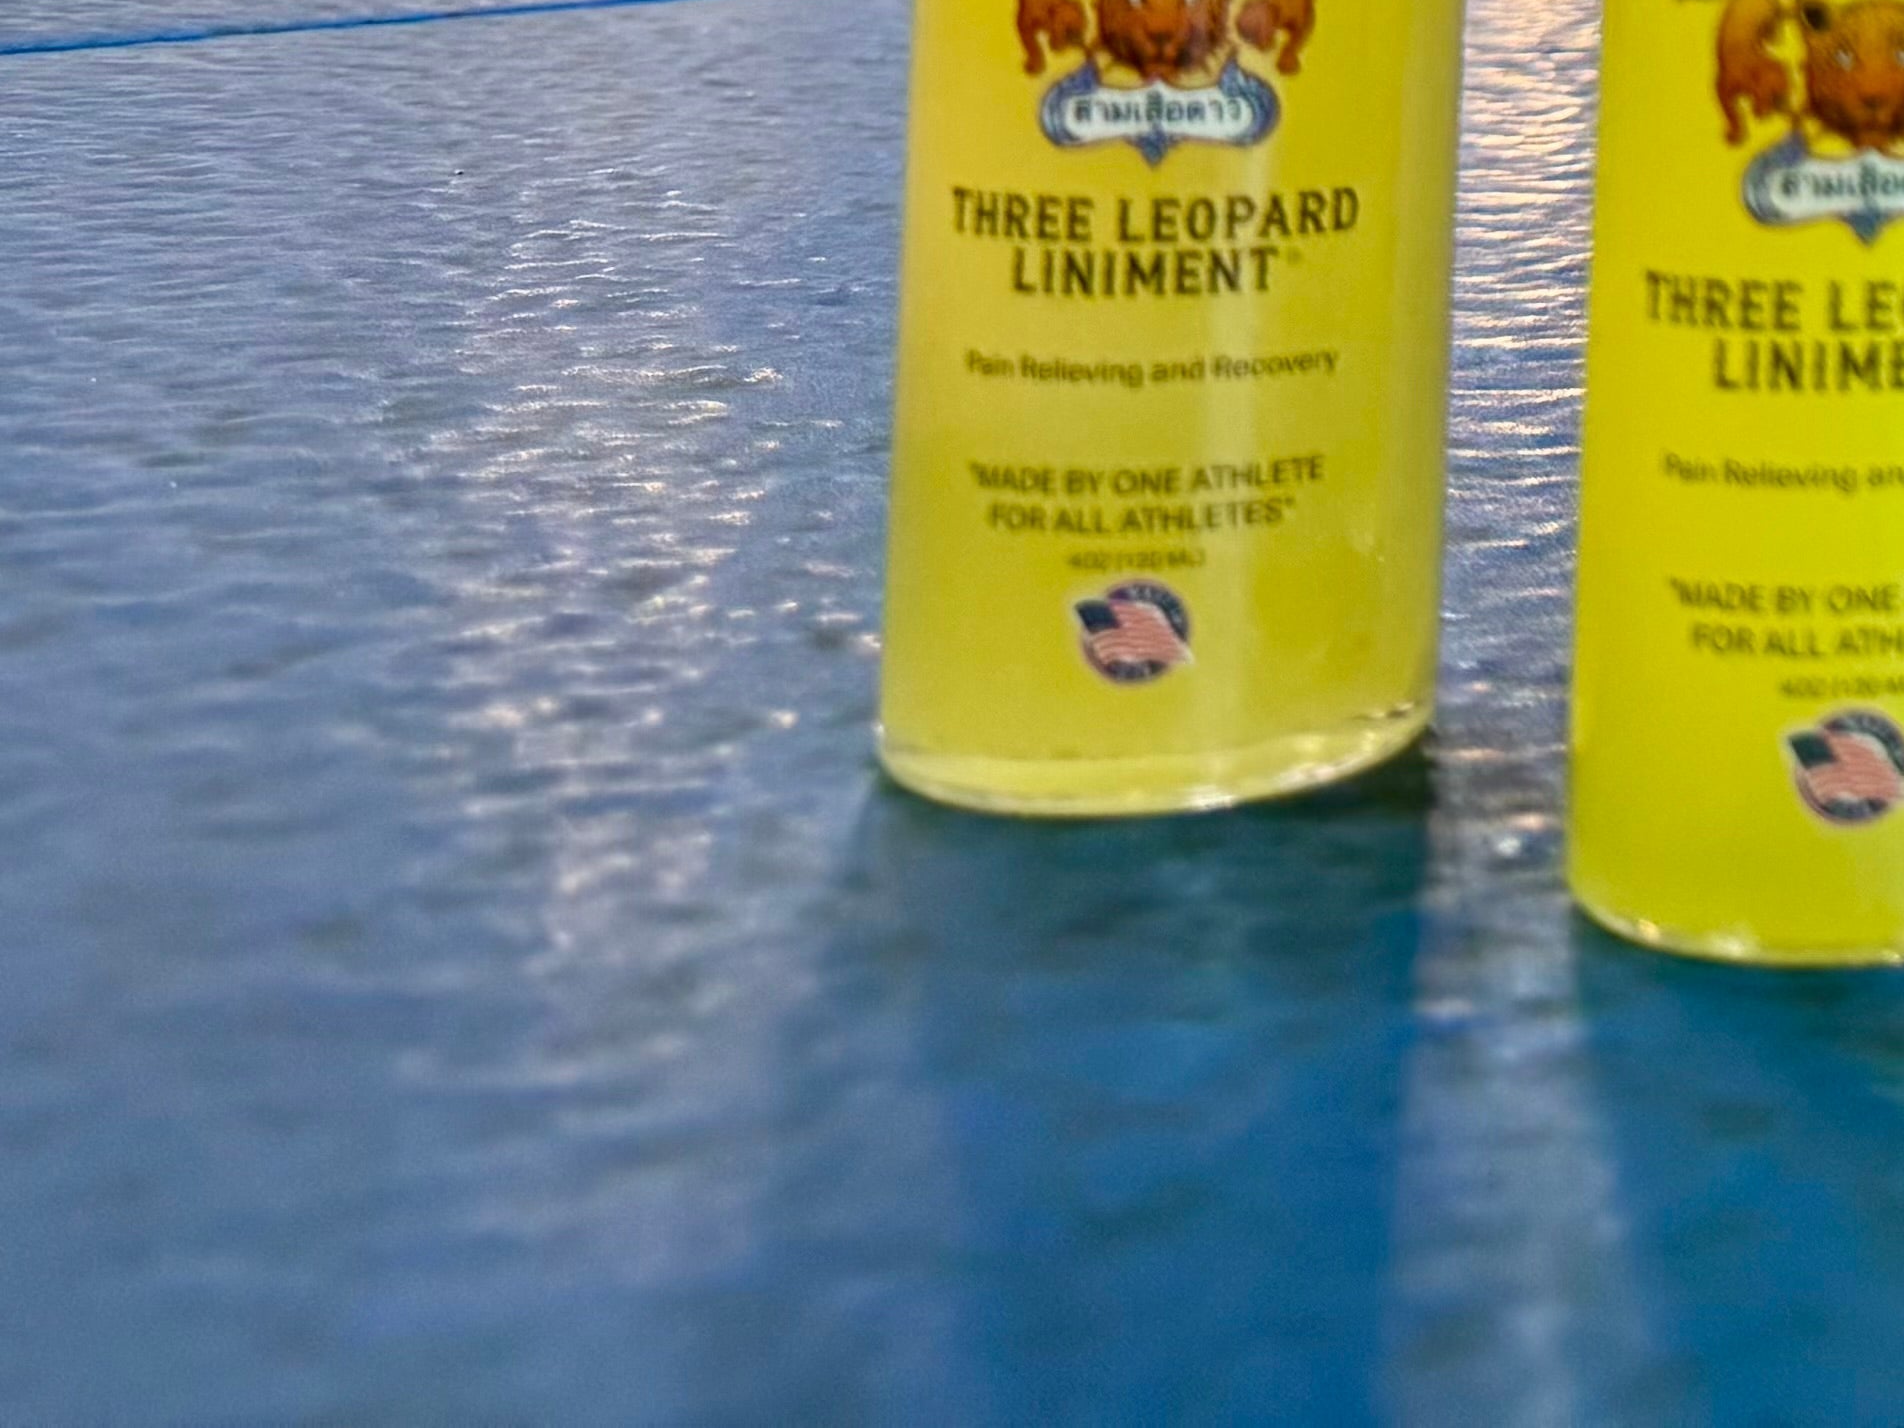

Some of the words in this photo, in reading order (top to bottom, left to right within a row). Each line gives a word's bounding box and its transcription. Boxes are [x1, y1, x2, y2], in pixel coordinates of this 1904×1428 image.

[952, 187, 1094, 242] THREE
[1117, 186, 1360, 243] LEOPARD
[1012, 246, 1279, 296] LINIMENT
[1645, 268, 1803, 332] THREE
[1151, 357, 1203, 382] and
[1212, 348, 1339, 379] Recovery
[1065, 469, 1104, 495] BY
[1113, 468, 1181, 496] ONE
[1191, 454, 1325, 491] ATHLETE
[988, 502, 1046, 532] FOR
[1054, 508, 1110, 534] ALL
[1775, 585, 1811, 614] BY
[1828, 583, 1899, 614] ONE
[1691, 621, 1756, 653] FOR
[1764, 626, 1824, 656] ALL
